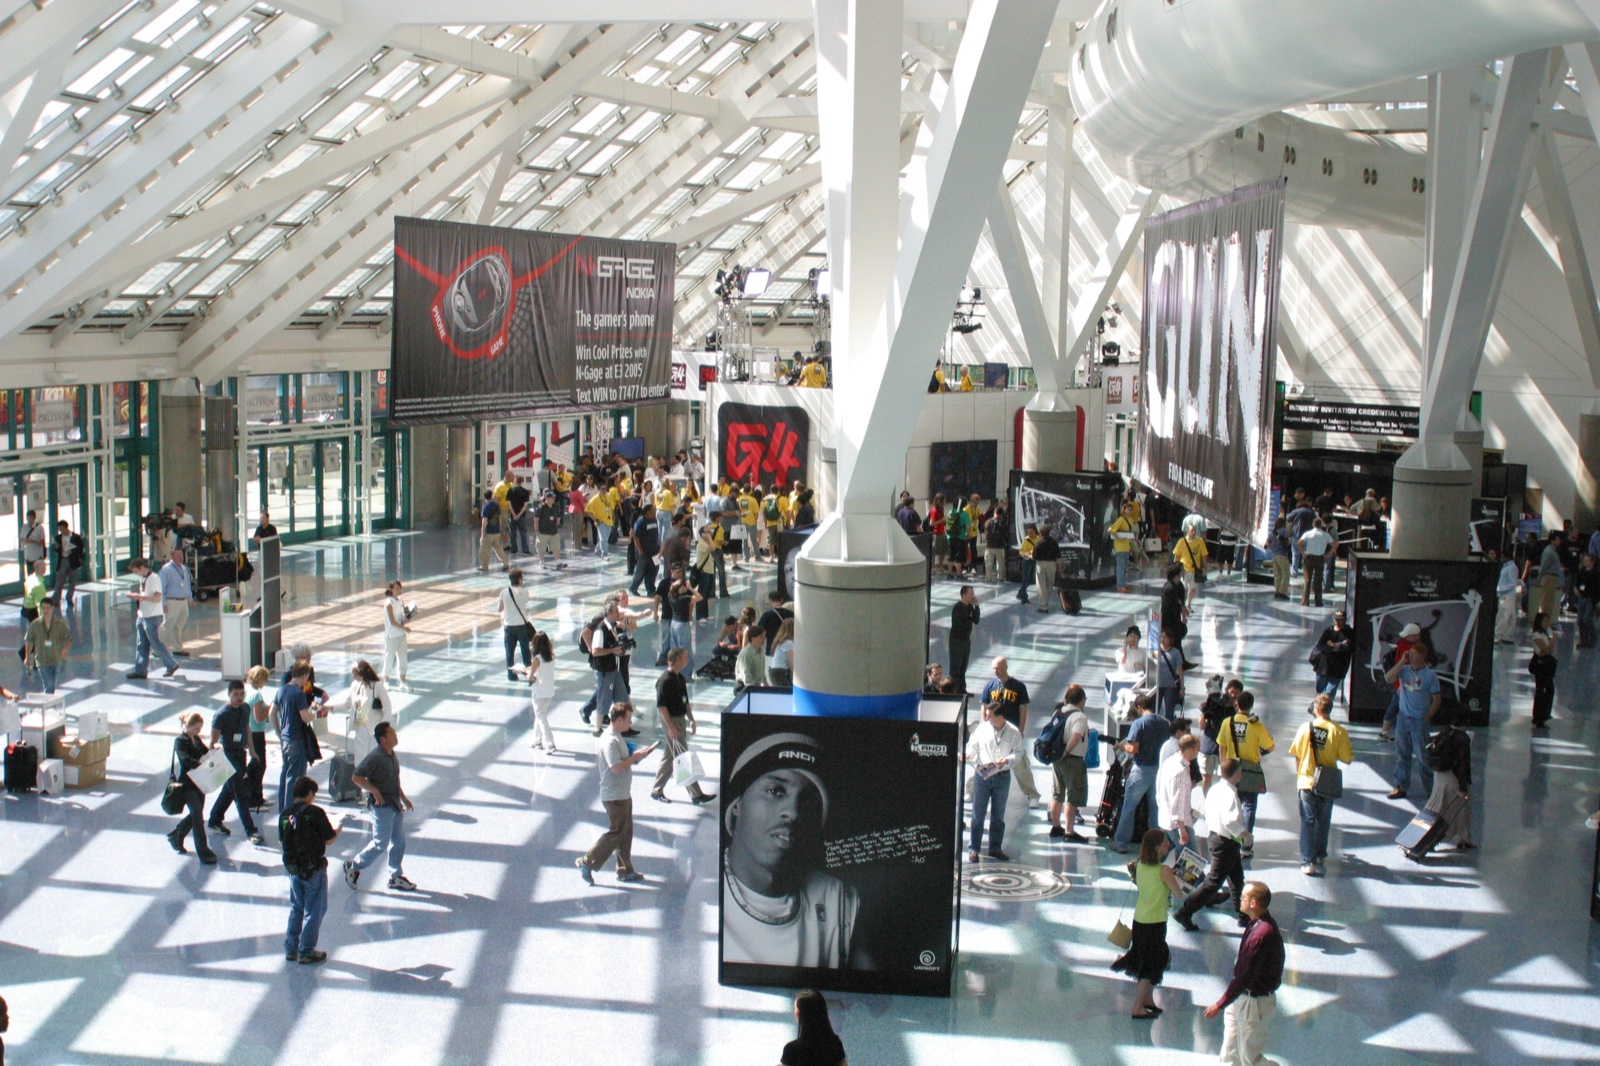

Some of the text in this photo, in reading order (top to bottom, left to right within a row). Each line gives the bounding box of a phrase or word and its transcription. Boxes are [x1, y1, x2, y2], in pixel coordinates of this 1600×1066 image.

[626, 287, 655, 299] NOKIA
[432, 305, 446, 340] PHONE
[576, 310, 655, 330] The gamer's phone
[490, 335, 504, 355] GAME
[575, 343, 648, 360] Win Cool Prizes with
[1147, 229, 1272, 490] GUN
[575, 362, 643, 382] N-Gage at E3 2005
[576, 388, 592, 403] Text
[592, 386, 609, 402] WIN
[609, 387, 618, 401] to
[619, 384, 640, 400] 77477
[640, 386, 648, 398] to
[1288, 404, 1320, 413] INDUSTRY
[1320, 406, 1358, 416] INVITATION
[1358, 407, 1399, 417] CREDENTIAL
[1301, 416, 1320, 425] Holding
[1328, 418, 1350, 426] Industry
[1376, 420, 1391, 428] Must
[1350, 425, 1380, 434] Credentials
[727, 422, 800, 488] G4
[1353, 464, 1361, 473] 2
[779, 750, 816, 764] AND1
